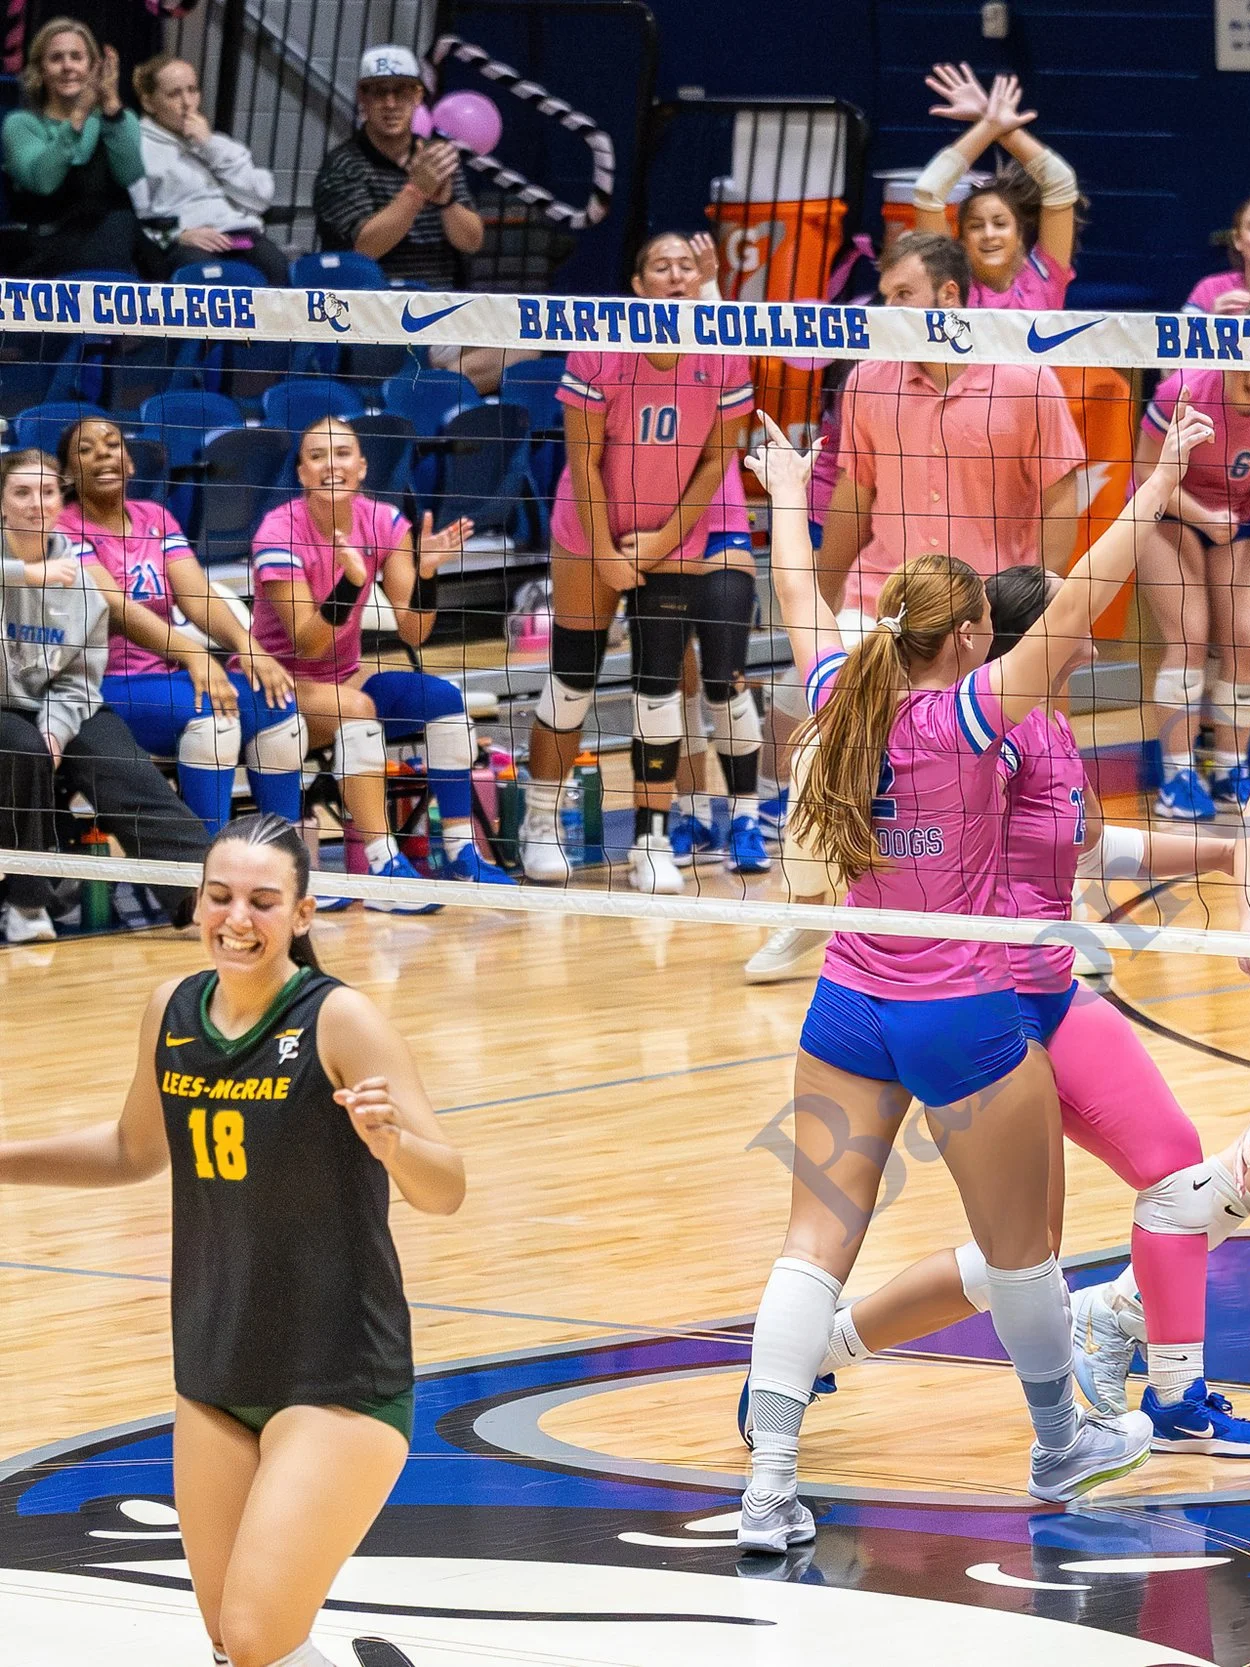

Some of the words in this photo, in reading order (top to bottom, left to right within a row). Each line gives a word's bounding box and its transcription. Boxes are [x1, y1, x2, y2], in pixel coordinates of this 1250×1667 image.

[0, 281, 81, 323] TON
[92, 283, 257, 329] COLLEGE
[518, 299, 681, 344] BARTON
[693, 304, 870, 350] COLLEGE
[640, 406, 680, 444] 10
[130, 563, 164, 601] 21
[188, 1108, 248, 1181] 18
